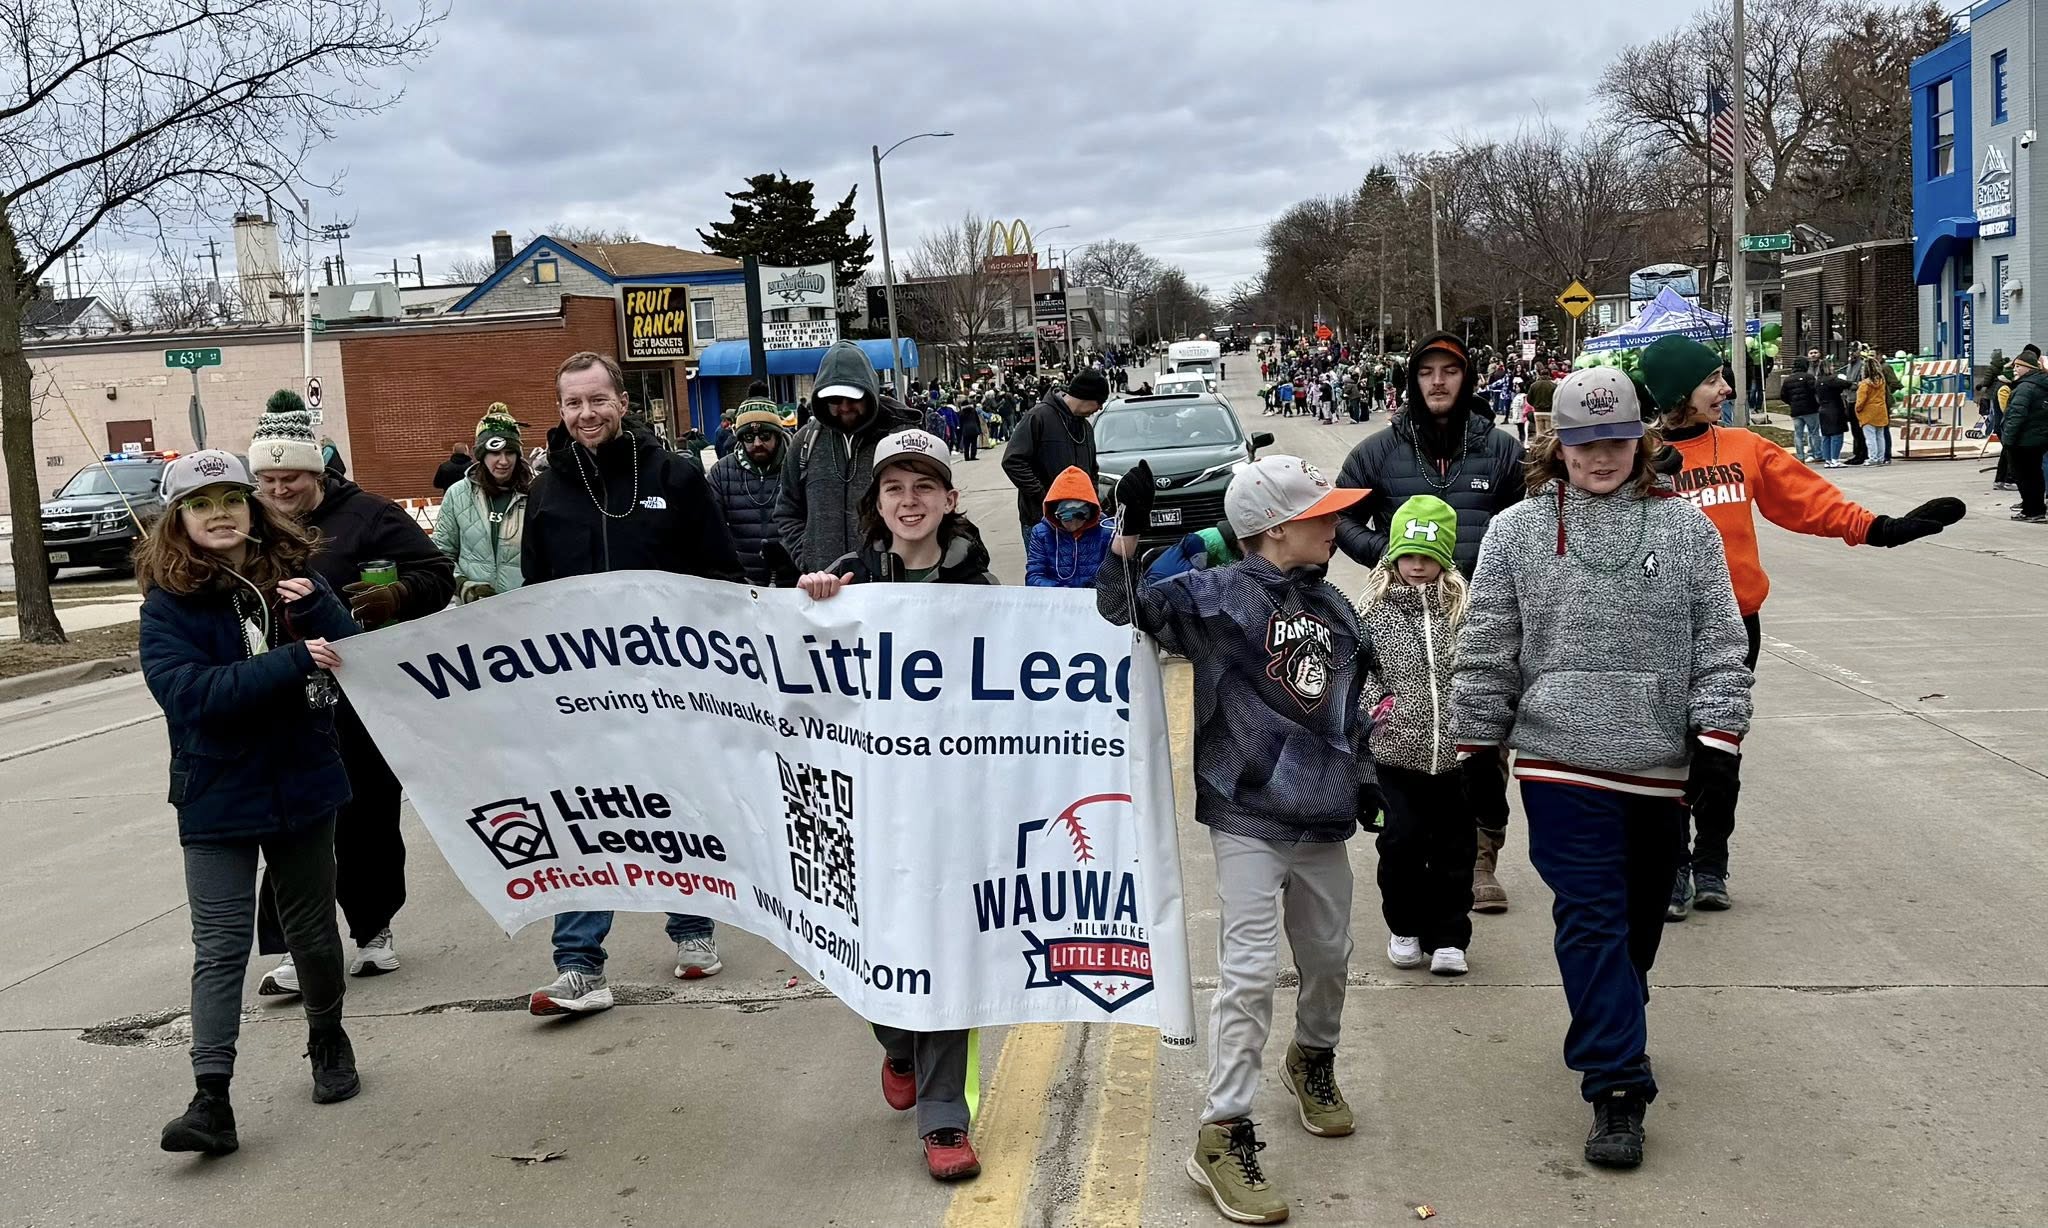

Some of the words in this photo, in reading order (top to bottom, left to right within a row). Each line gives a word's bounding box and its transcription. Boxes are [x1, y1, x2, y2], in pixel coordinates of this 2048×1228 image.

[627, 287, 671, 315] FRUIT
[633, 310, 684, 338] RANCH
[633, 338, 649, 348] GIFT
[650, 337, 683, 347] BASKETS
[397, 616, 767, 700] Wauwatosa
[766, 632, 943, 701] Little
[556, 690, 648, 715] Serving
[651, 687, 686, 711] the
[778, 717, 798, 737] &
[939, 730, 1125, 757] communities
[550, 785, 672, 822] Little
[568, 823, 727, 864] League
[506, 862, 619, 900] Official
[624, 863, 737, 901] Program
[973, 870, 1138, 932] WAUWA
[752, 885, 931, 995] www.tosamll.com
[1073, 922, 1149, 940] MILWAUKE
[1053, 946, 1106, 966] LITTLE
